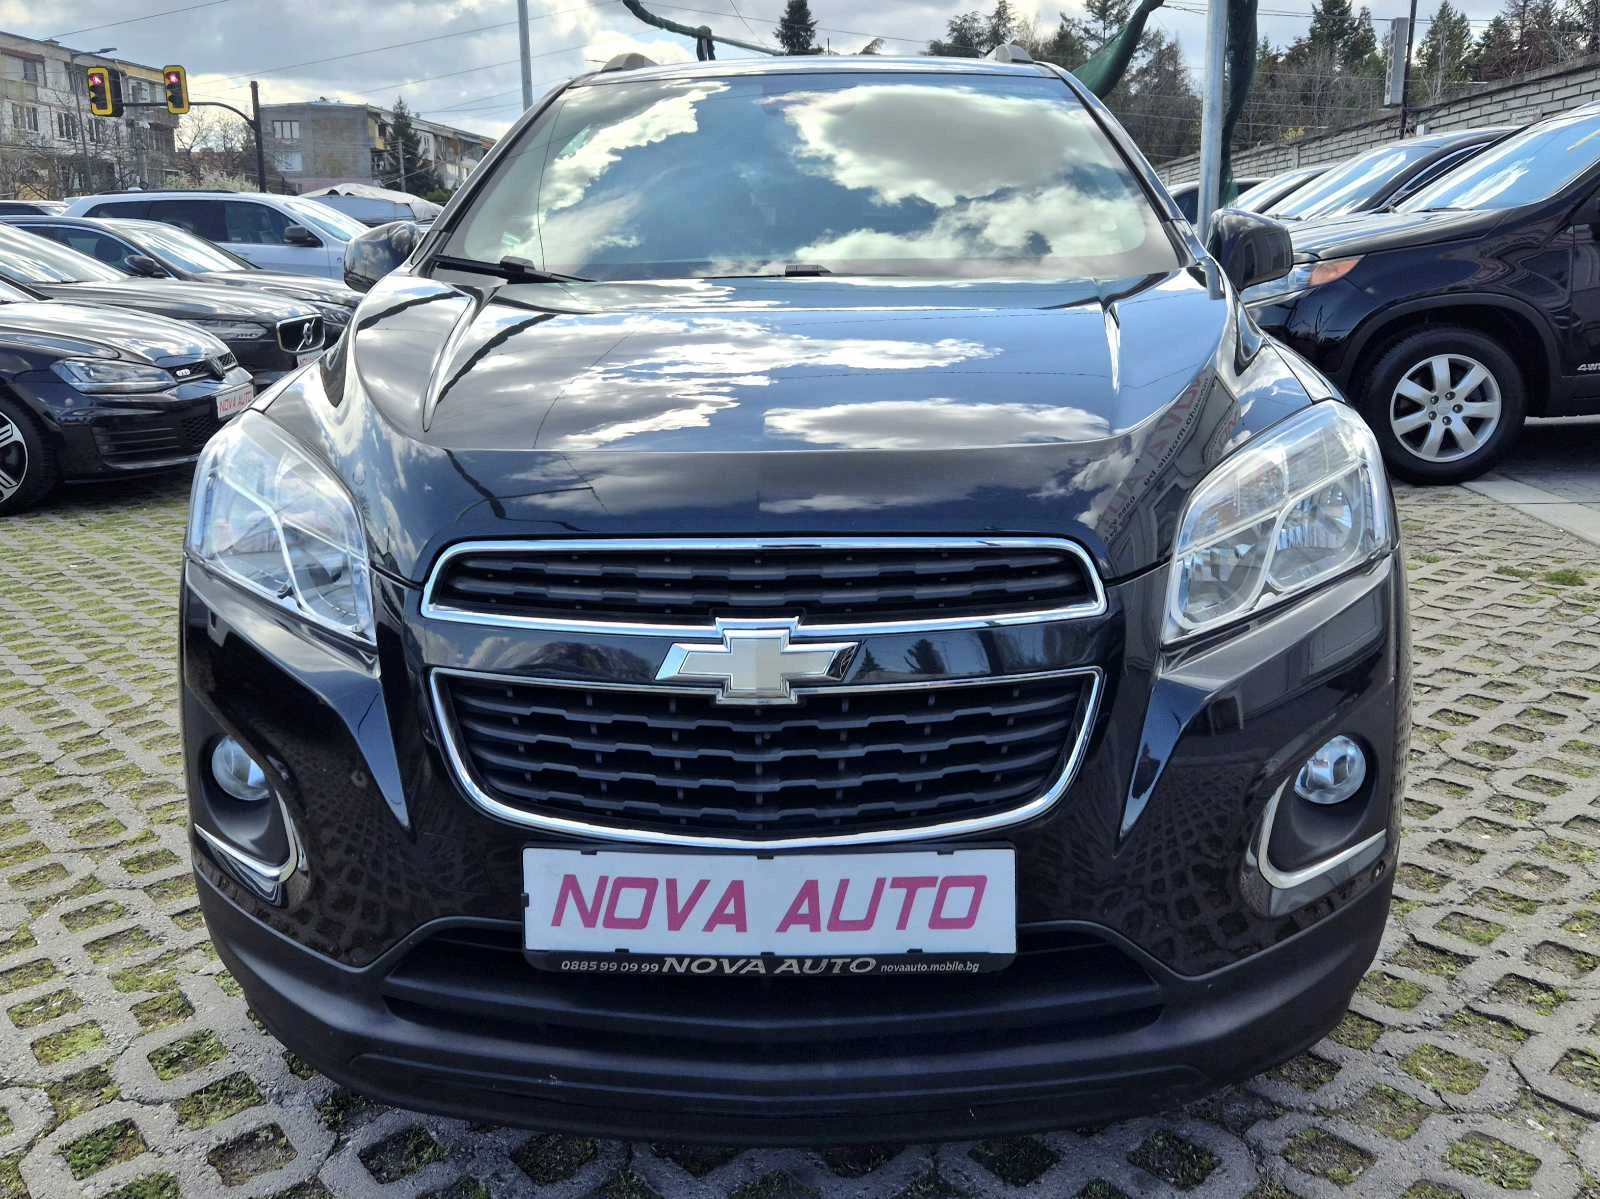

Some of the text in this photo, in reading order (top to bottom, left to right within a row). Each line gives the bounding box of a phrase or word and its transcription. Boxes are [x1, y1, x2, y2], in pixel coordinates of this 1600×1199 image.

[550, 873, 989, 933] NOVA AUTO
[561, 956, 980, 975] 0885 99 09 99 NOVA AUTO novaauto.mobile.bg
